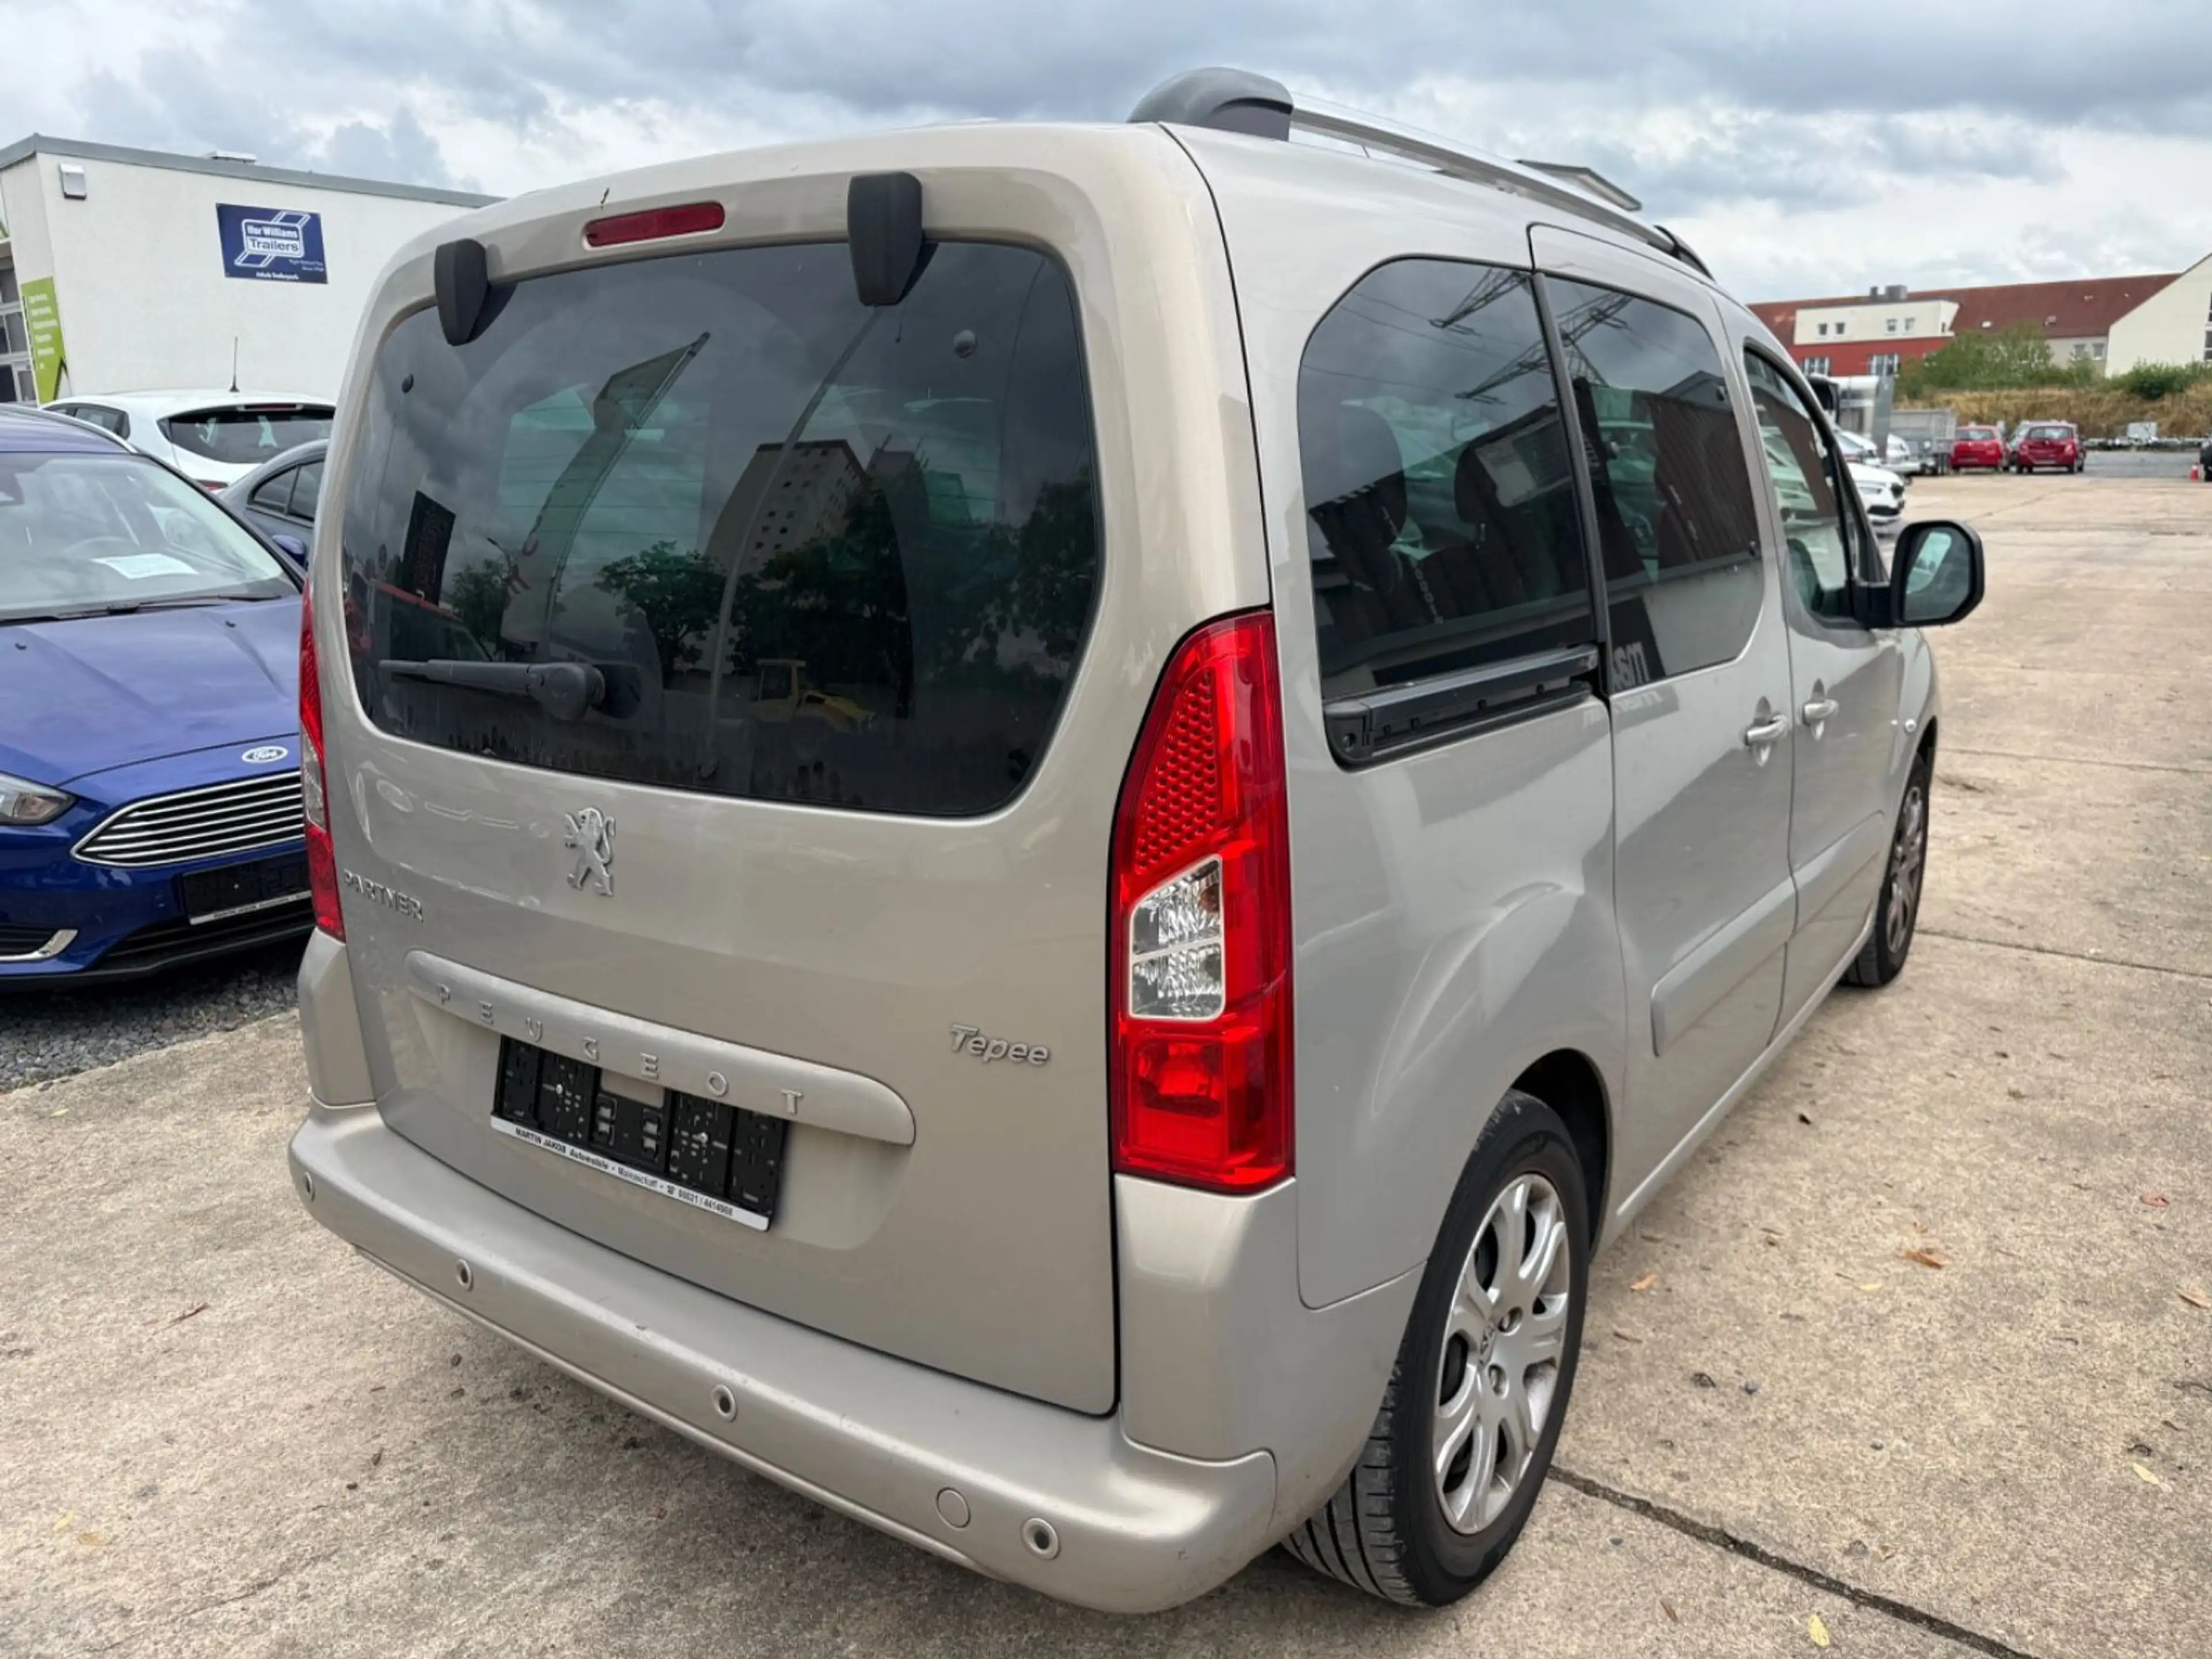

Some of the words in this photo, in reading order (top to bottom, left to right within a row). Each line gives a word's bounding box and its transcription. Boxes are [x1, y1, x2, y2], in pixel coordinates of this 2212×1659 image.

[249, 238, 298, 251] Trailers
[344, 869, 424, 923] PARTNER
[436, 983, 804, 1115] PEUGEOT
[950, 1023, 1051, 1066] Tepee
[515, 1127, 541, 1144] MARTIN
[543, 1138, 567, 1154] JAKOB
